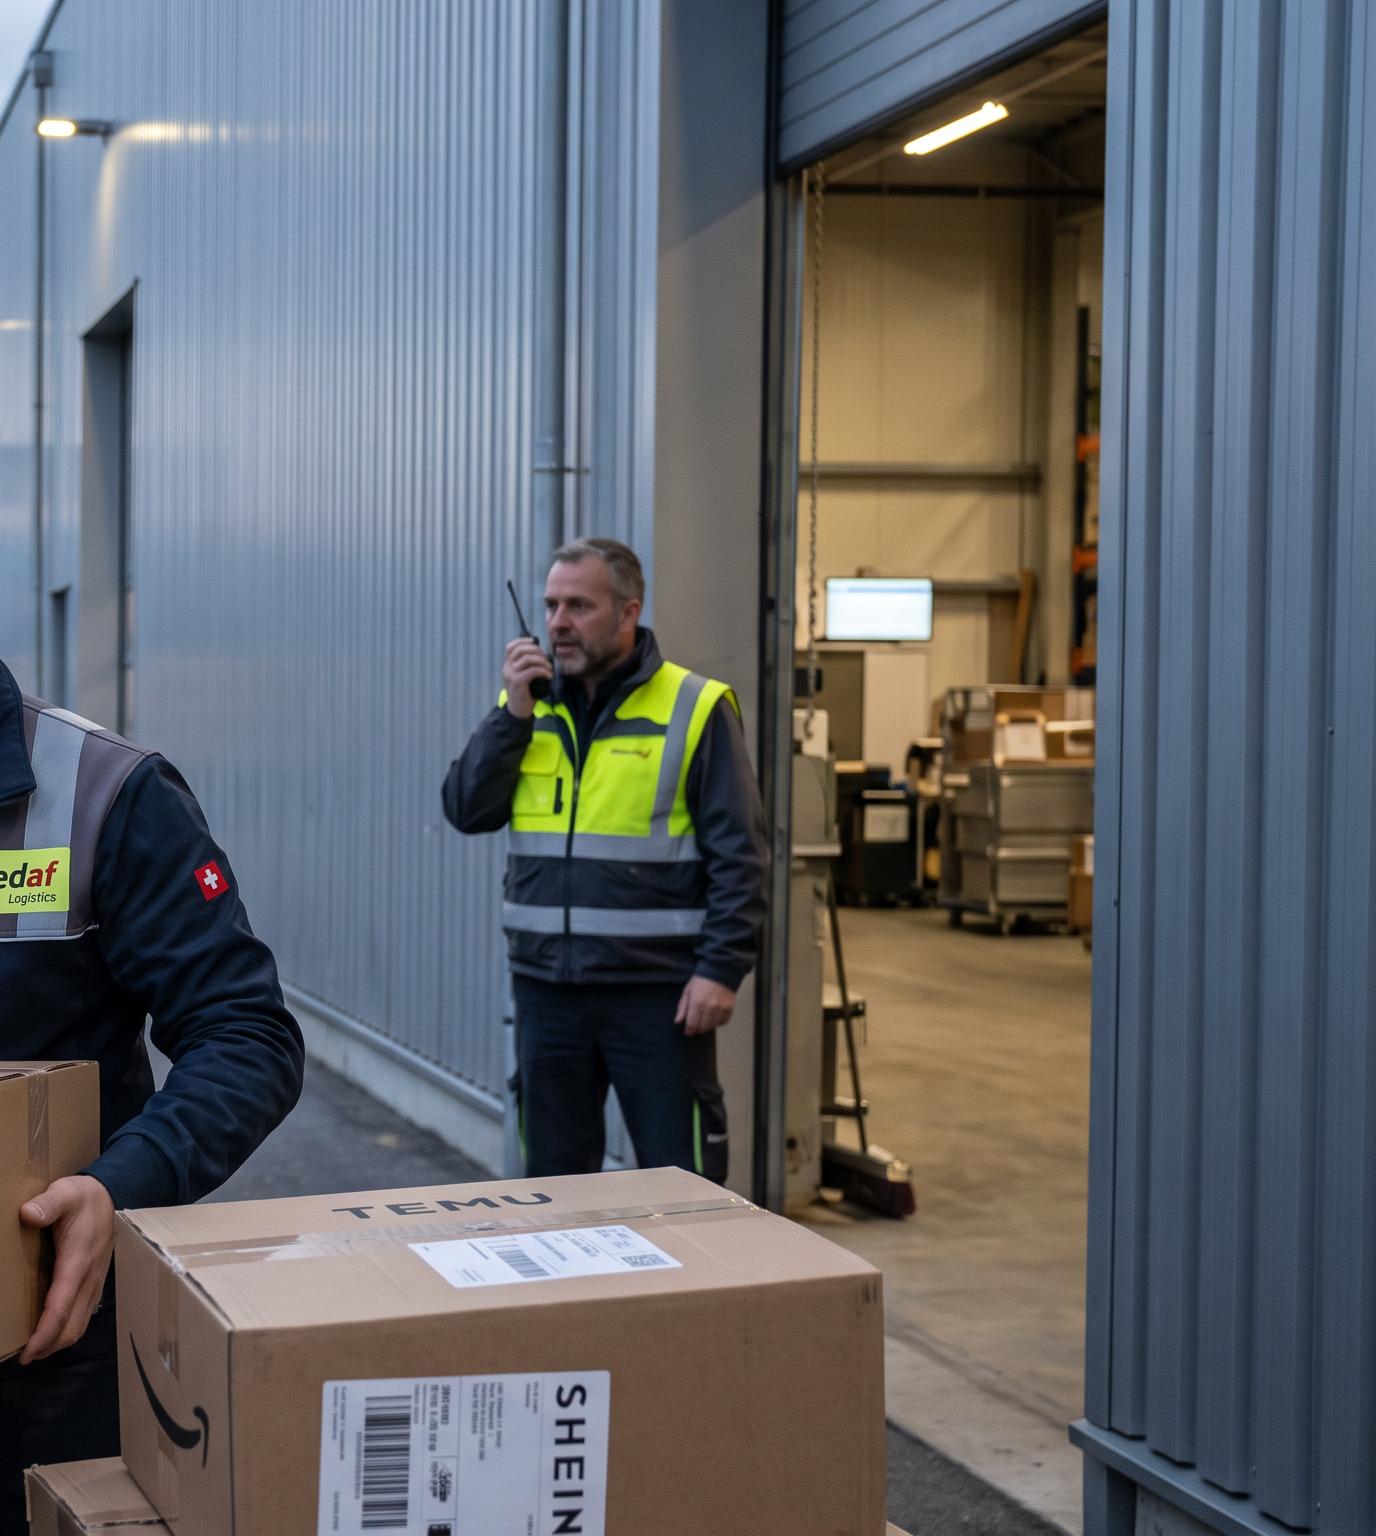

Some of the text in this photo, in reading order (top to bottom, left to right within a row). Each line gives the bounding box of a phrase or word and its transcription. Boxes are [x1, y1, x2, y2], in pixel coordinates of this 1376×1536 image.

[8, 892, 57, 906] Logistics
[332, 1192, 552, 1220] TEMU
[552, 1383, 587, 1535] SHEIN
